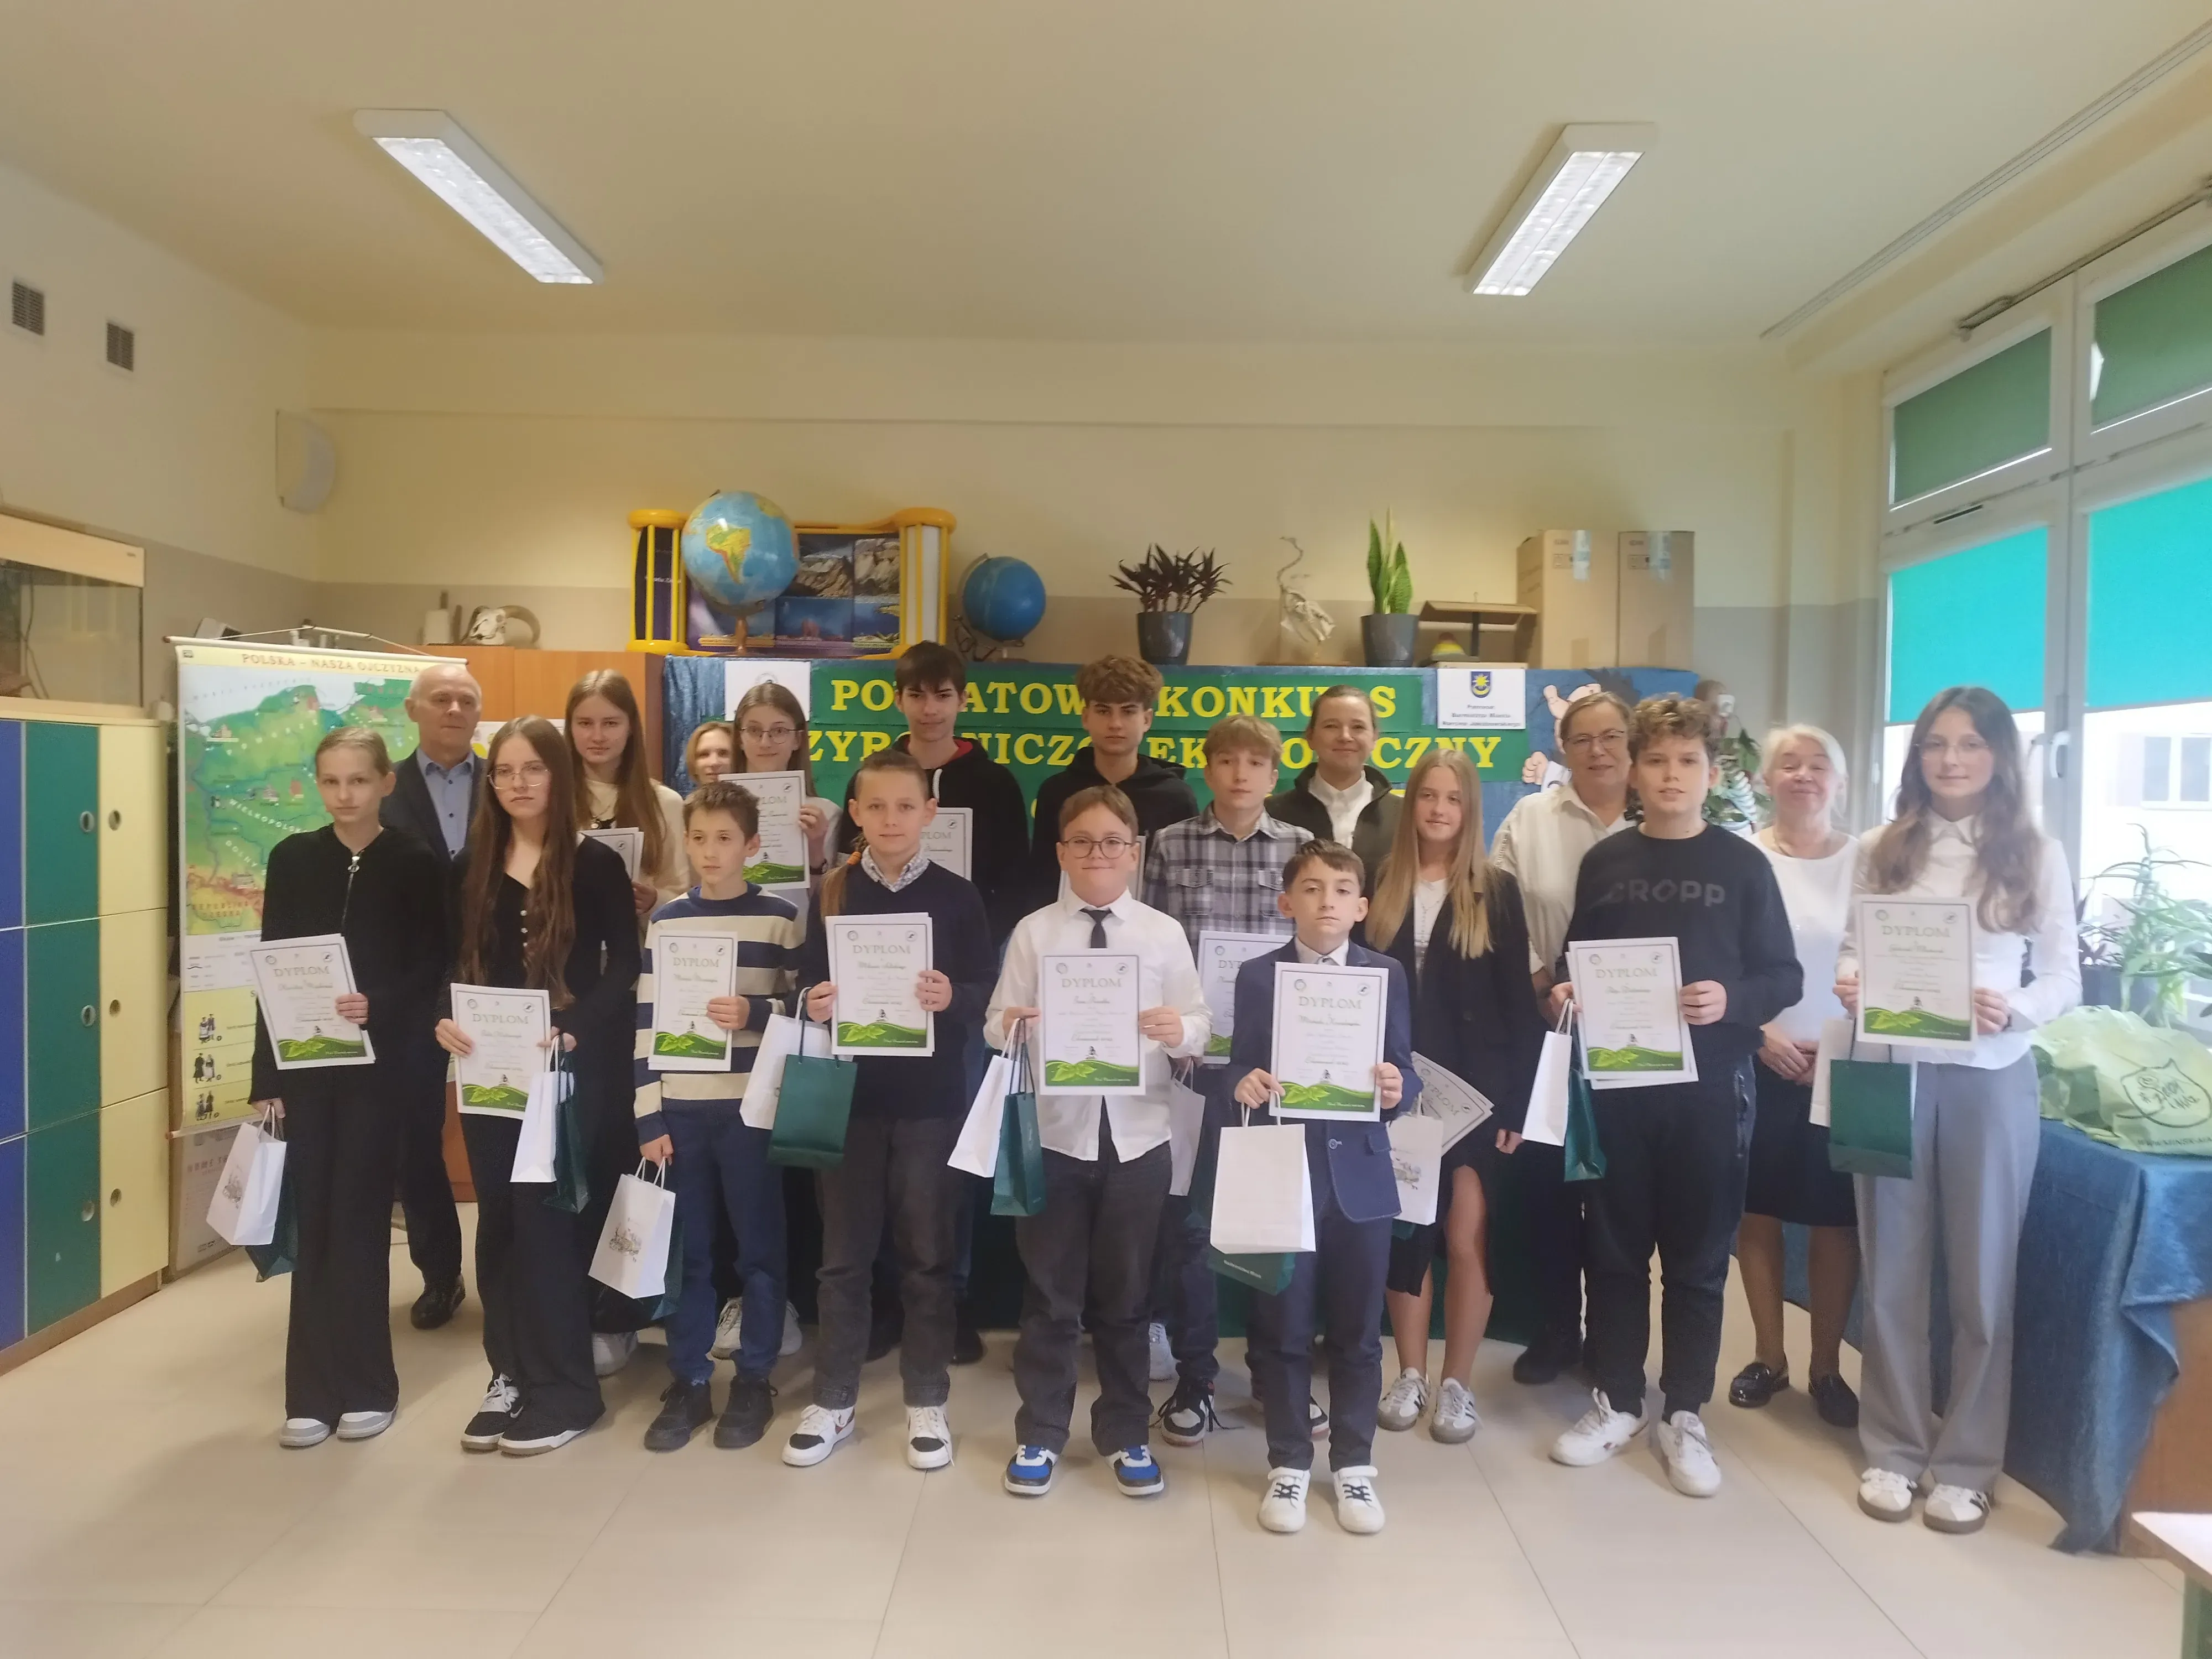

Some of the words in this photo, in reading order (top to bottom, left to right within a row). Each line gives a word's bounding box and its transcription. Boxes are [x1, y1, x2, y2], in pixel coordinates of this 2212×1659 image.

[242, 653, 296, 666] POLSKA
[311, 659, 354, 670] NASZA
[357, 661, 420, 674] OJCZYZNA
[831, 679, 1087, 716] POATOW
[1154, 686, 1396, 718] KONKUS
[1882, 925, 1951, 937] DYPLOM
[853, 945, 911, 954] DYPLOM
[673, 957, 719, 968] DYPLOM
[1219, 960, 1243, 968] DYP
[273, 966, 330, 977] DYPLOM
[1595, 968, 1657, 978] DYPLOM
[1062, 978, 1122, 988] DYPLOM
[1298, 996, 1363, 1009] DYPLOM
[473, 1014, 529, 1024] DYPLOM
